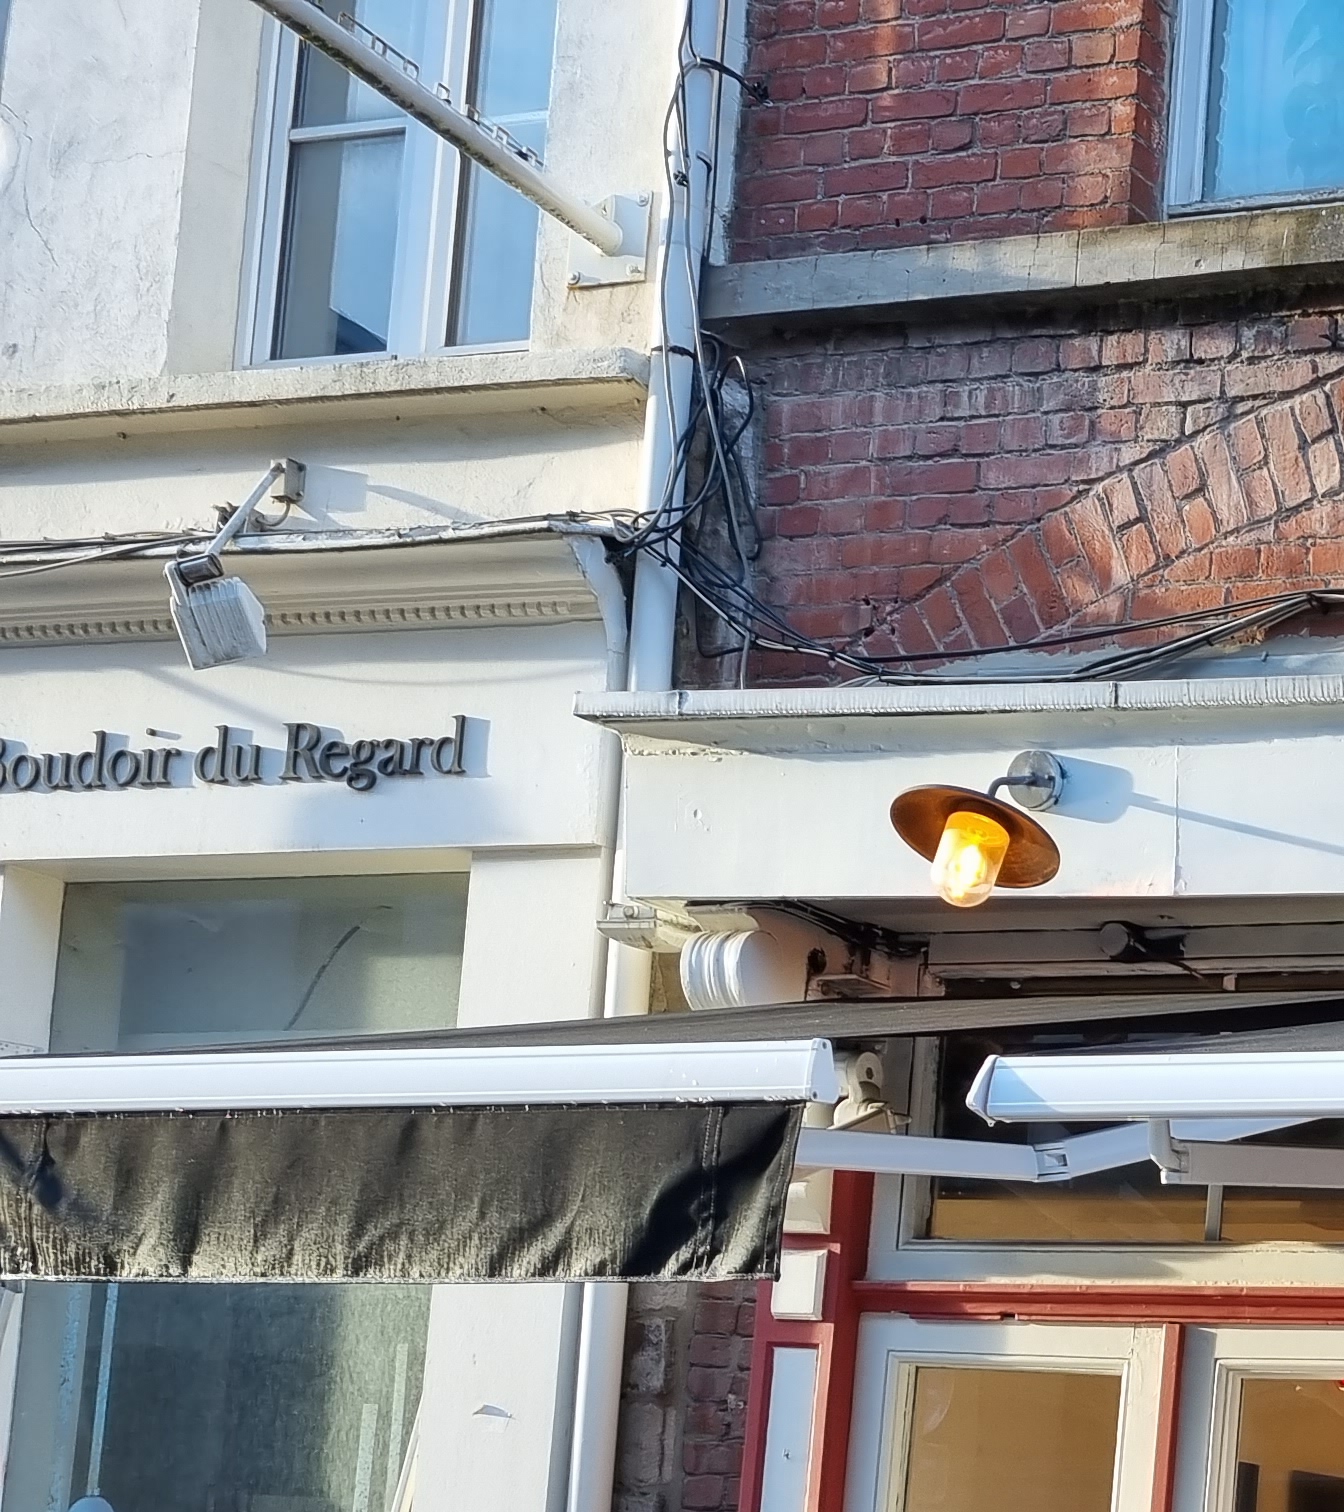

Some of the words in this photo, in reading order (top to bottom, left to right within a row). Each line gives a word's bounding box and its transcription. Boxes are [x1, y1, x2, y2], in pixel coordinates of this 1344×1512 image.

[0, 729, 181, 789] oudoir
[194, 725, 262, 783] du
[279, 714, 467, 791] Regard
